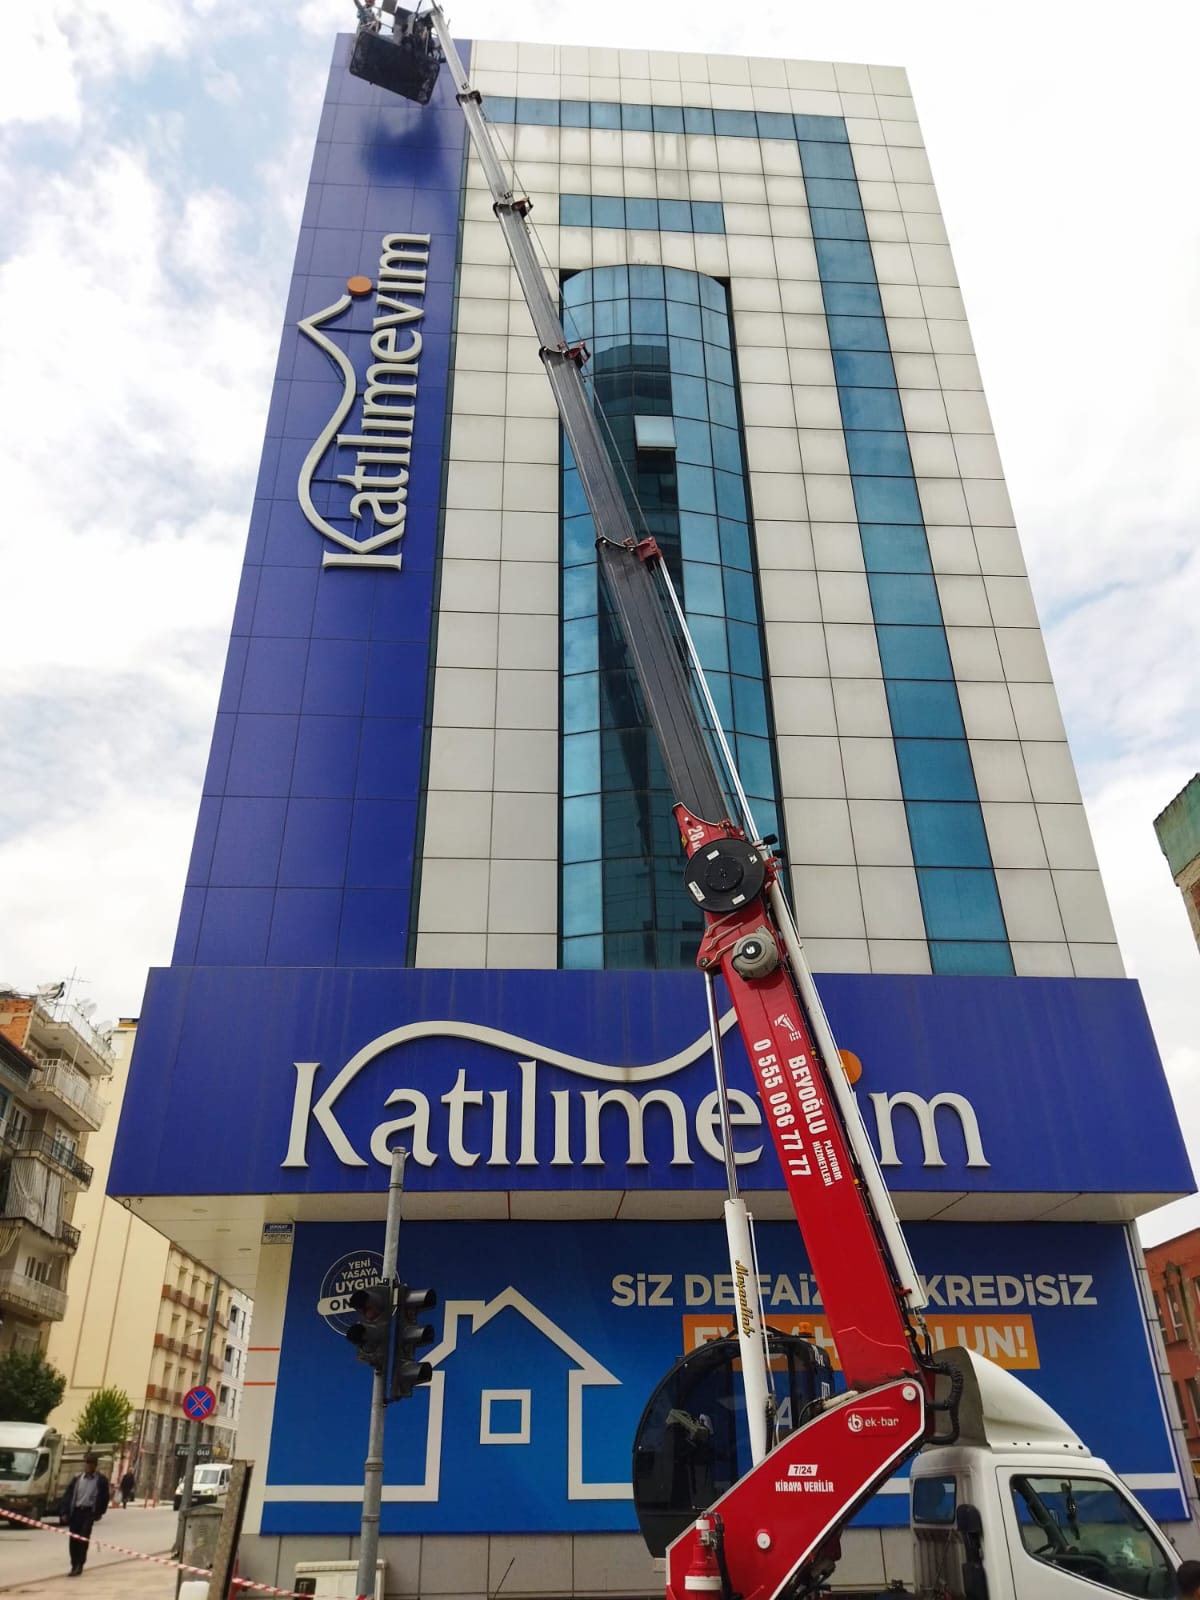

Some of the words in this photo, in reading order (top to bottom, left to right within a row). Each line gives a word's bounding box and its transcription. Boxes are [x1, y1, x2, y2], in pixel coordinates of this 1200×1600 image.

[688, 825, 704, 841] 28
[753, 1039, 772, 1052] 0
[758, 1054, 783, 1089] 555
[788, 1054, 828, 1135] BEYOĞLU
[769, 1091, 795, 1128] 066
[781, 1129, 804, 1151] 77
[788, 1155, 812, 1177] 77
[823, 1140, 842, 1180] PLATFORM
[342, 1268, 378, 1280] YASAYA
[348, 1258, 370, 1270] YENİ
[685, 1274, 735, 1306] DE
[793, 1466, 812, 1475] 7/24
